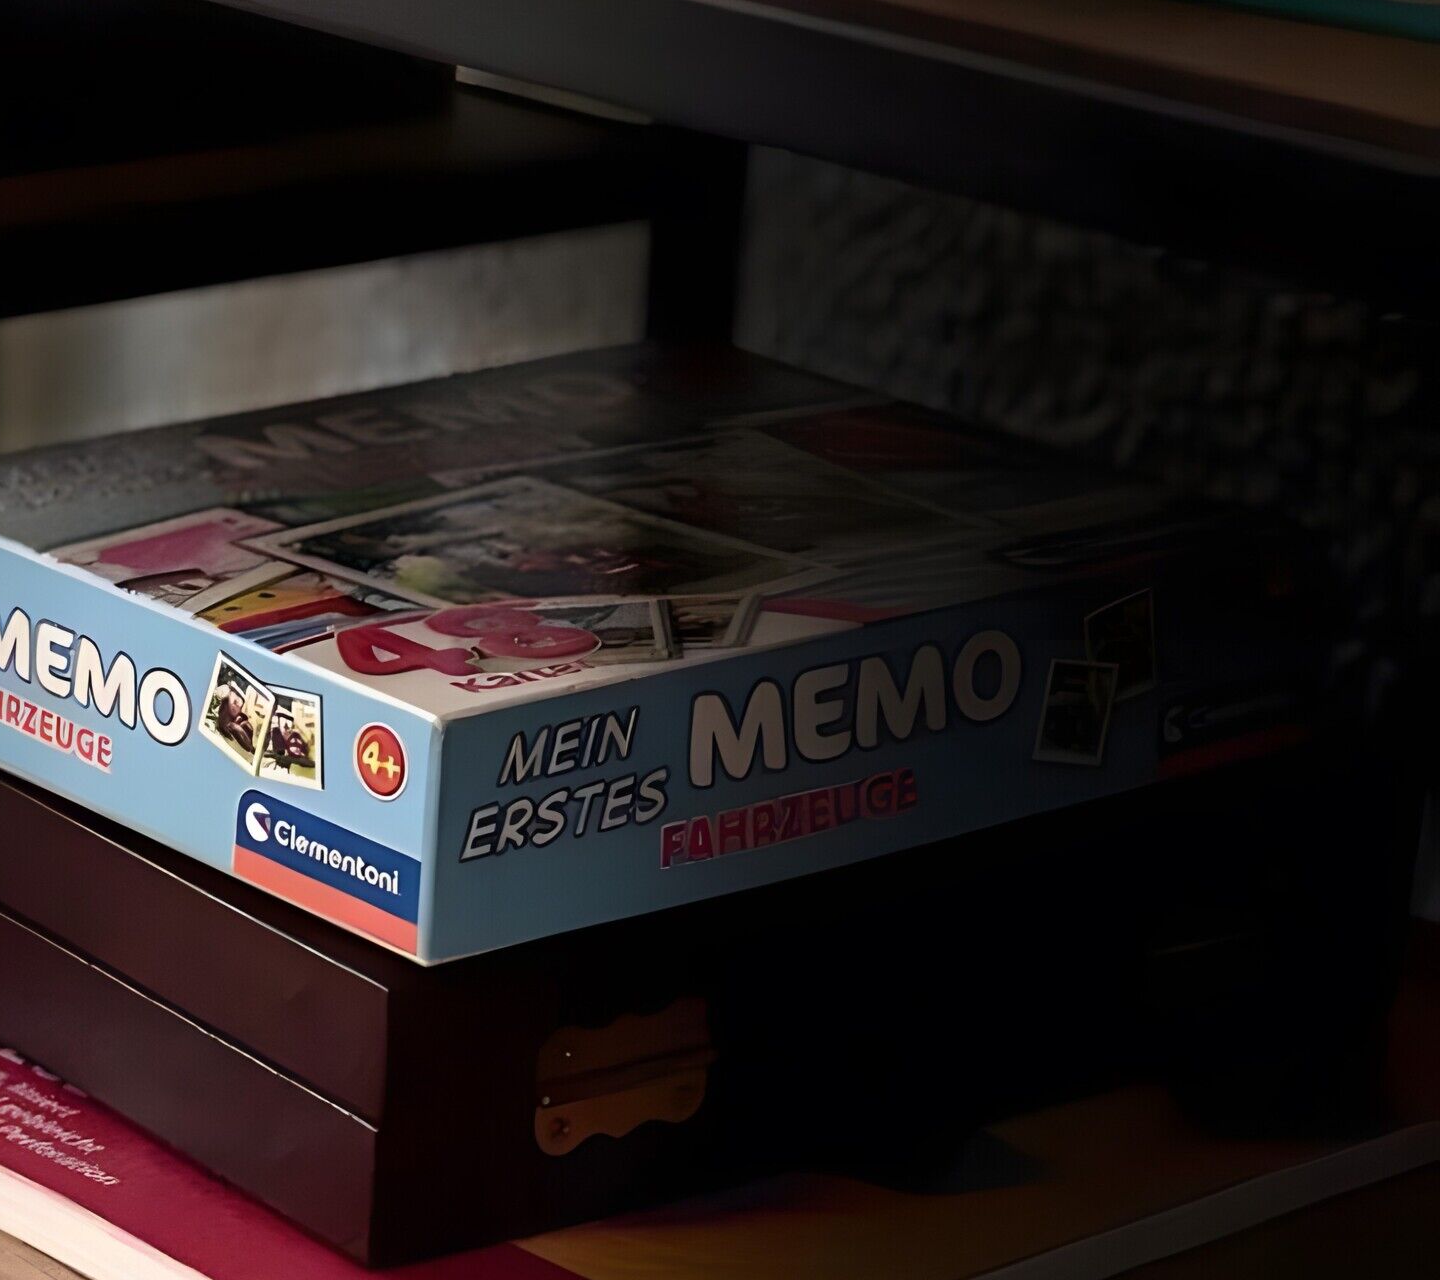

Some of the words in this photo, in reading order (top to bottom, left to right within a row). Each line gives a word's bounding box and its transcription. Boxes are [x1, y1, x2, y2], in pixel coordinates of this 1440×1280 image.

[498, 705, 641, 788] MEIN
[688, 628, 1025, 790] MEMO
[362, 741, 402, 781] 4+
[274, 821, 401, 896] Clementoni
[459, 766, 669, 863] ERSTES
[661, 769, 919, 867] FAHRZEUGE
